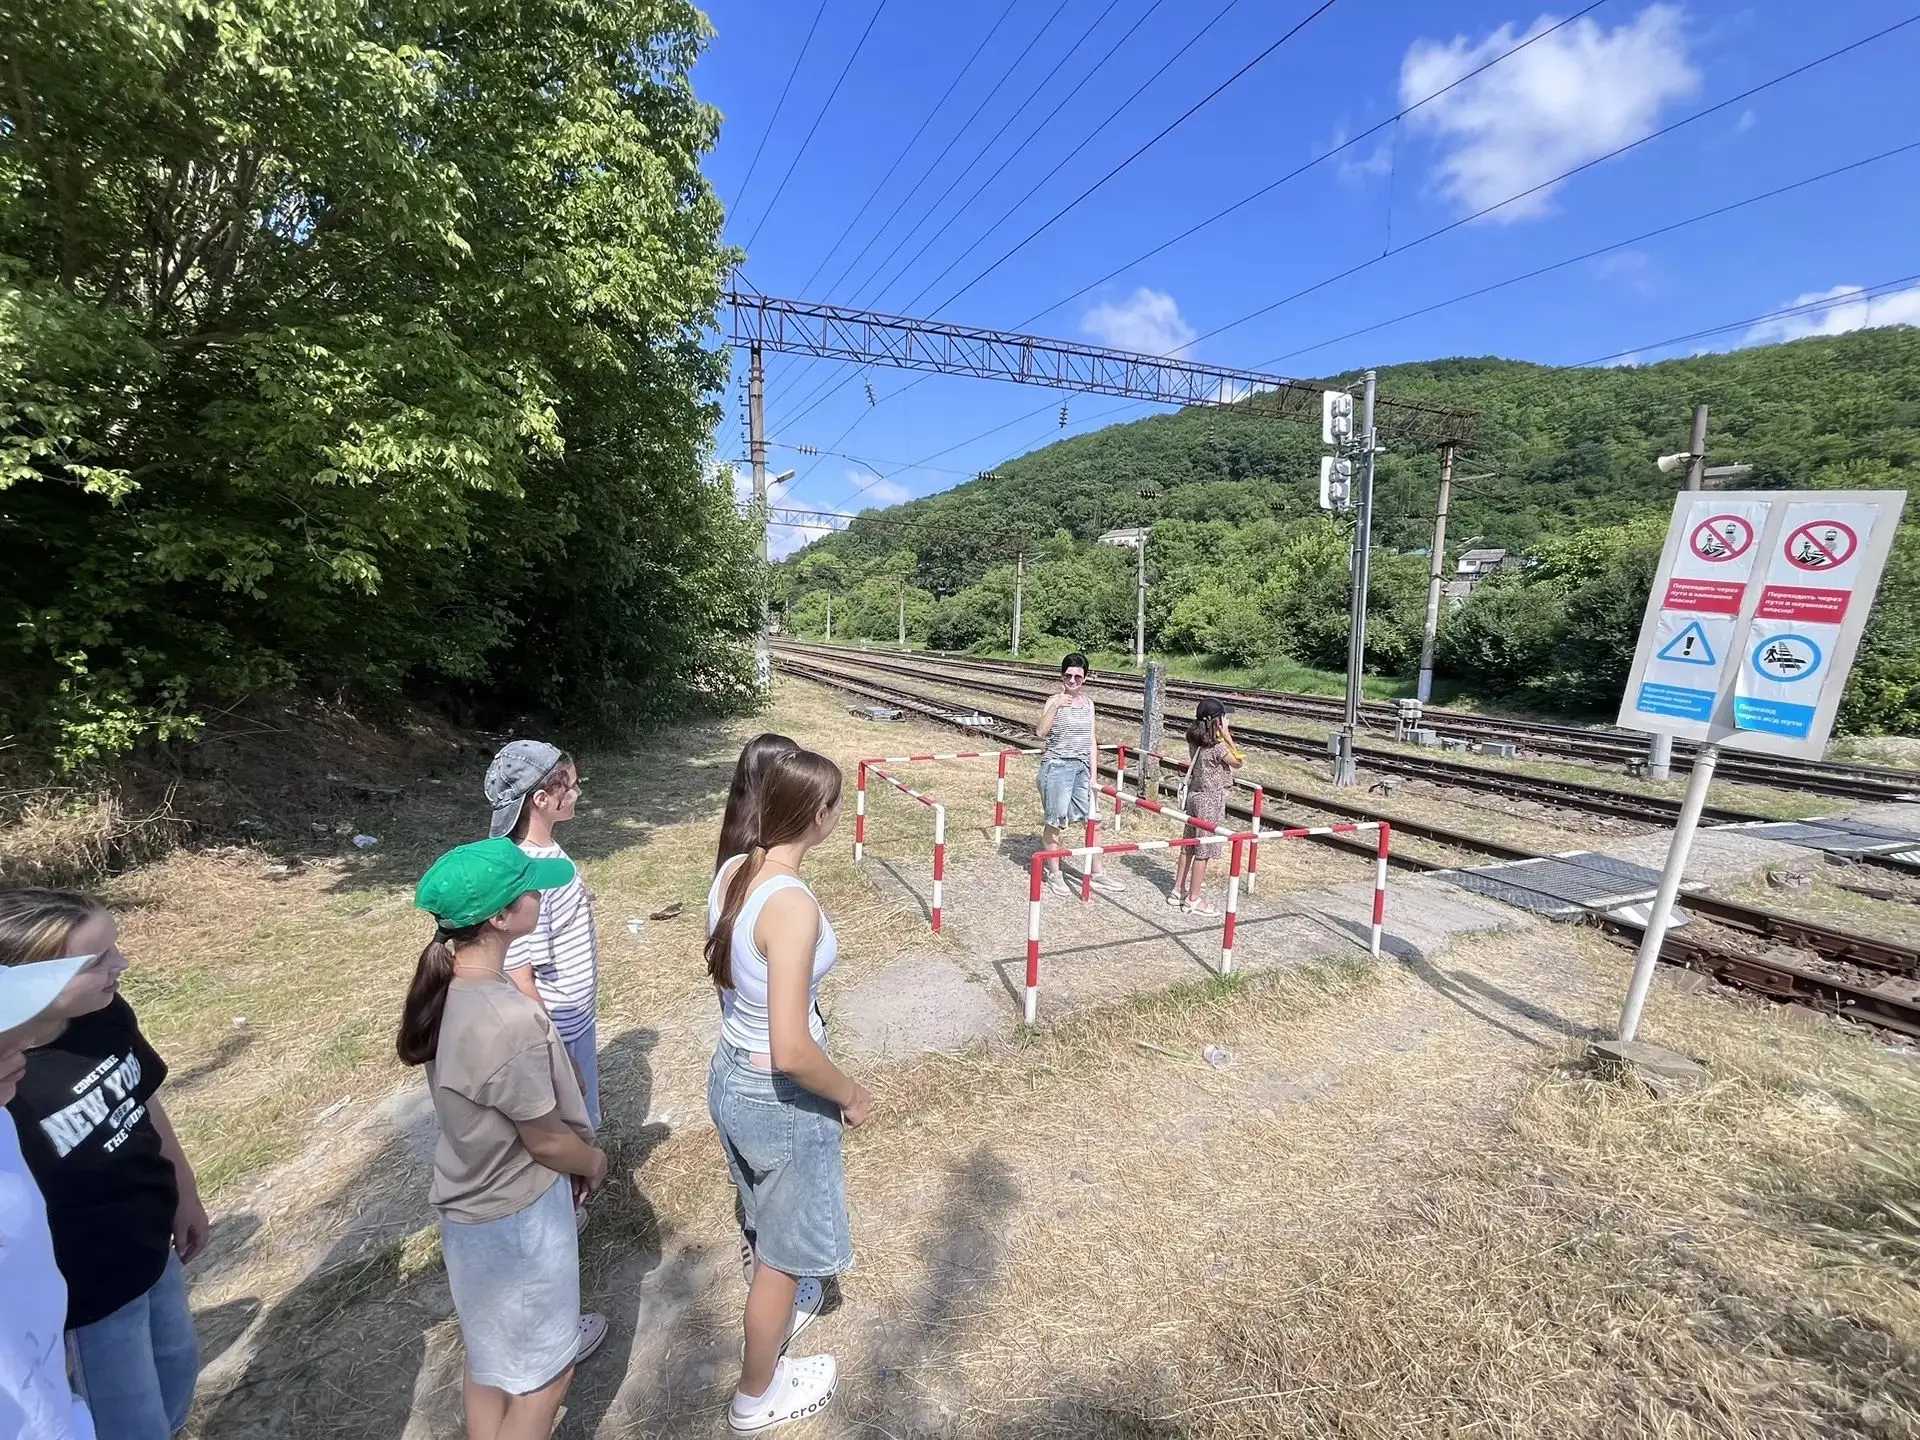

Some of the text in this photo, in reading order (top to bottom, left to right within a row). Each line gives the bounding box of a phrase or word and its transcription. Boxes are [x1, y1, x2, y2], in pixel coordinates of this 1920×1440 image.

[1767, 591, 1816, 600] Переходить
[1739, 704, 1777, 715] Переход
[39, 1086, 110, 1158] NEW
[103, 1128, 129, 1153] THE
[790, 1389, 833, 1419] crocs
